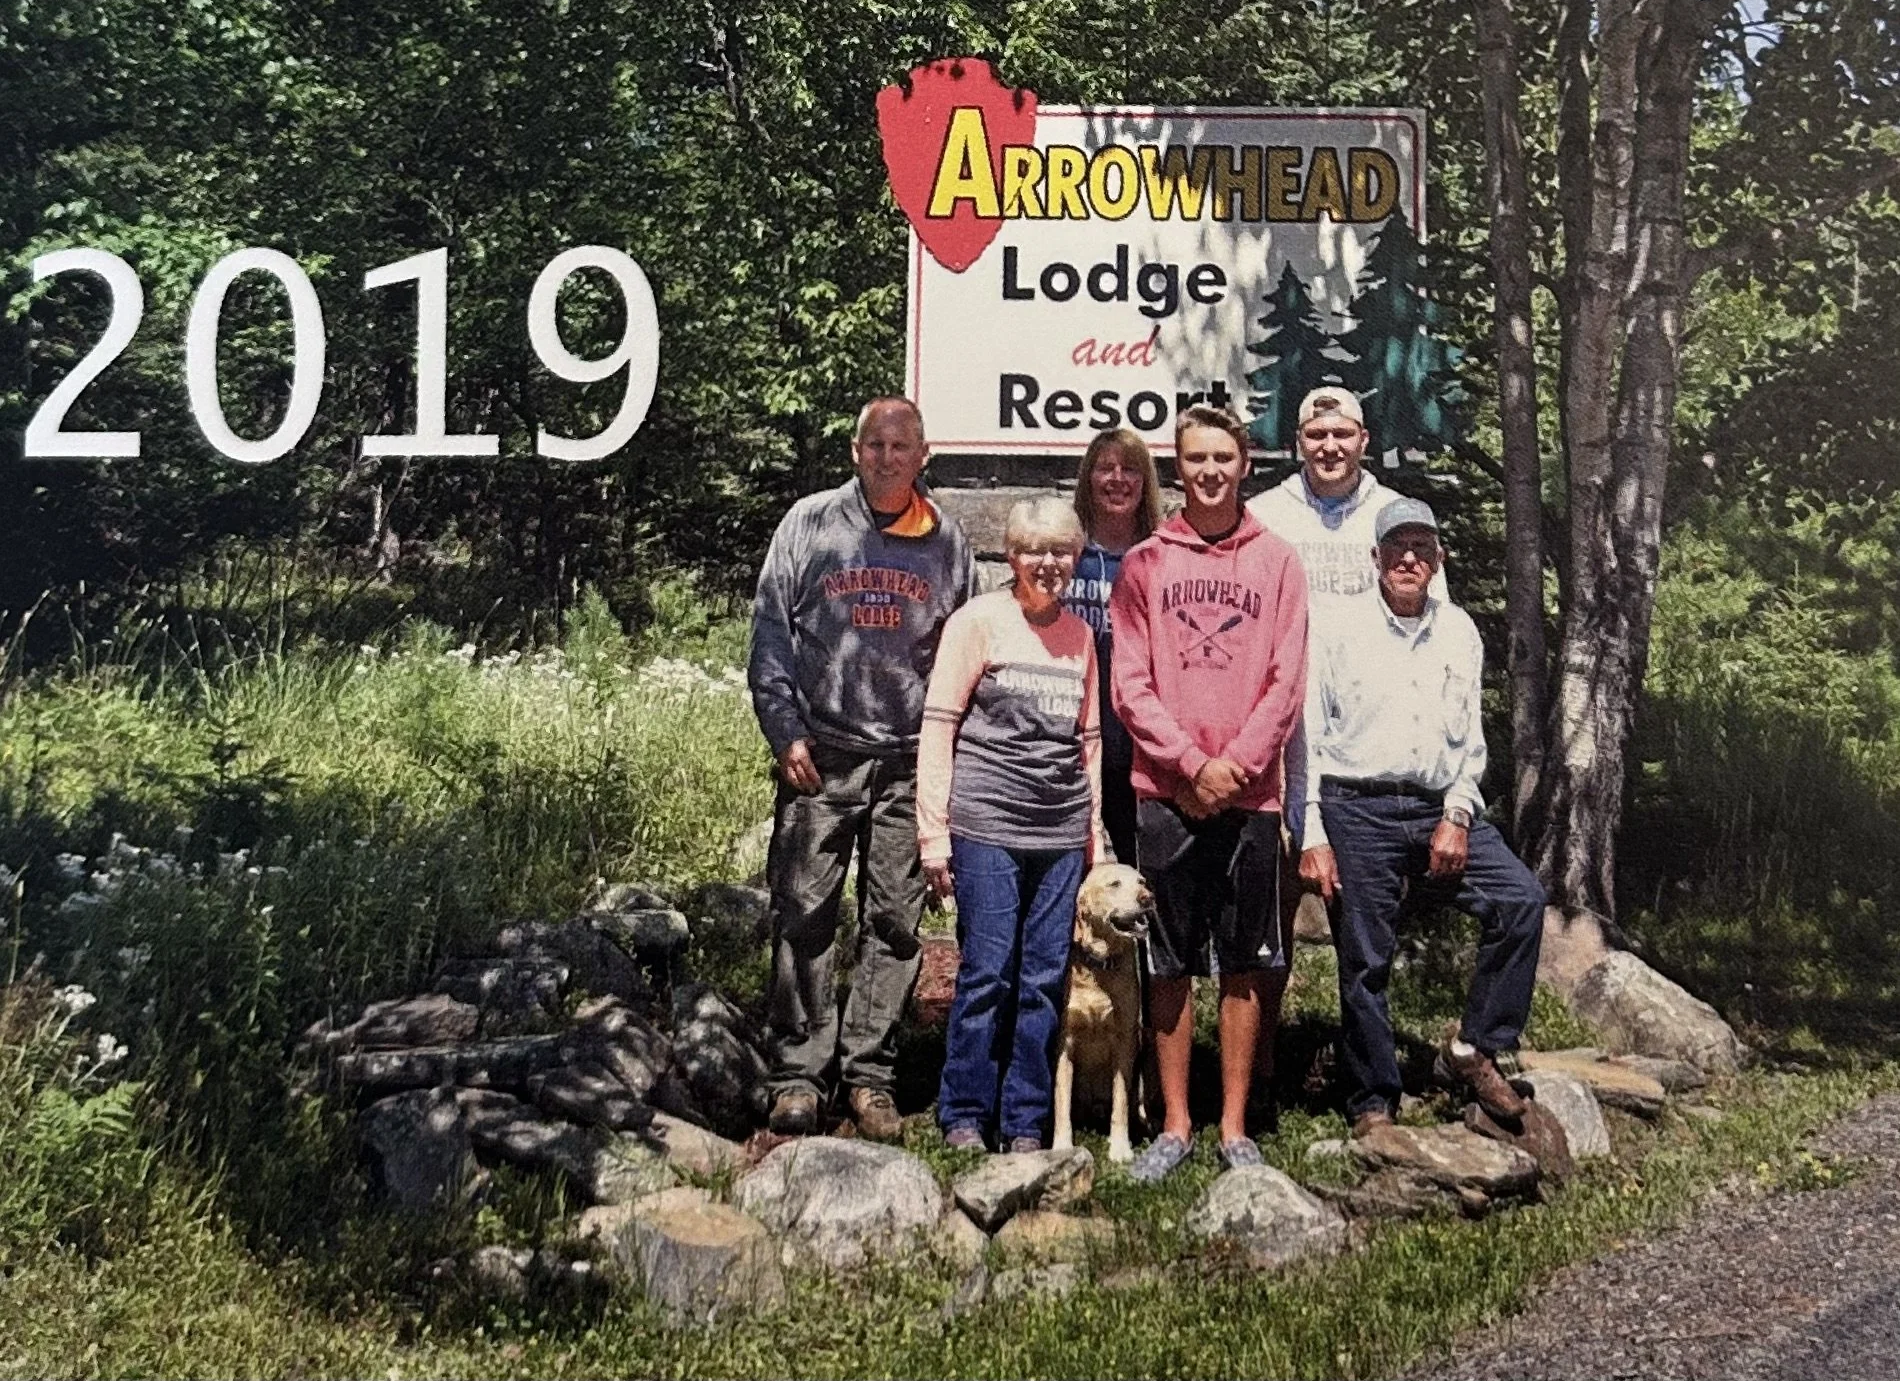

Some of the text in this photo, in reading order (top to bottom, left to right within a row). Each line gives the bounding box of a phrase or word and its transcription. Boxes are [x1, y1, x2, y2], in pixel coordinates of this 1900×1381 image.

[926, 105, 1400, 224] ARROWHEAD
[1001, 244, 1228, 317] Lodge
[1071, 324, 1161, 367] and
[825, 567, 930, 603] ARROWHEAD
[1161, 578, 1262, 620] ARROWHEAD
[853, 603, 901, 629] LODGE
